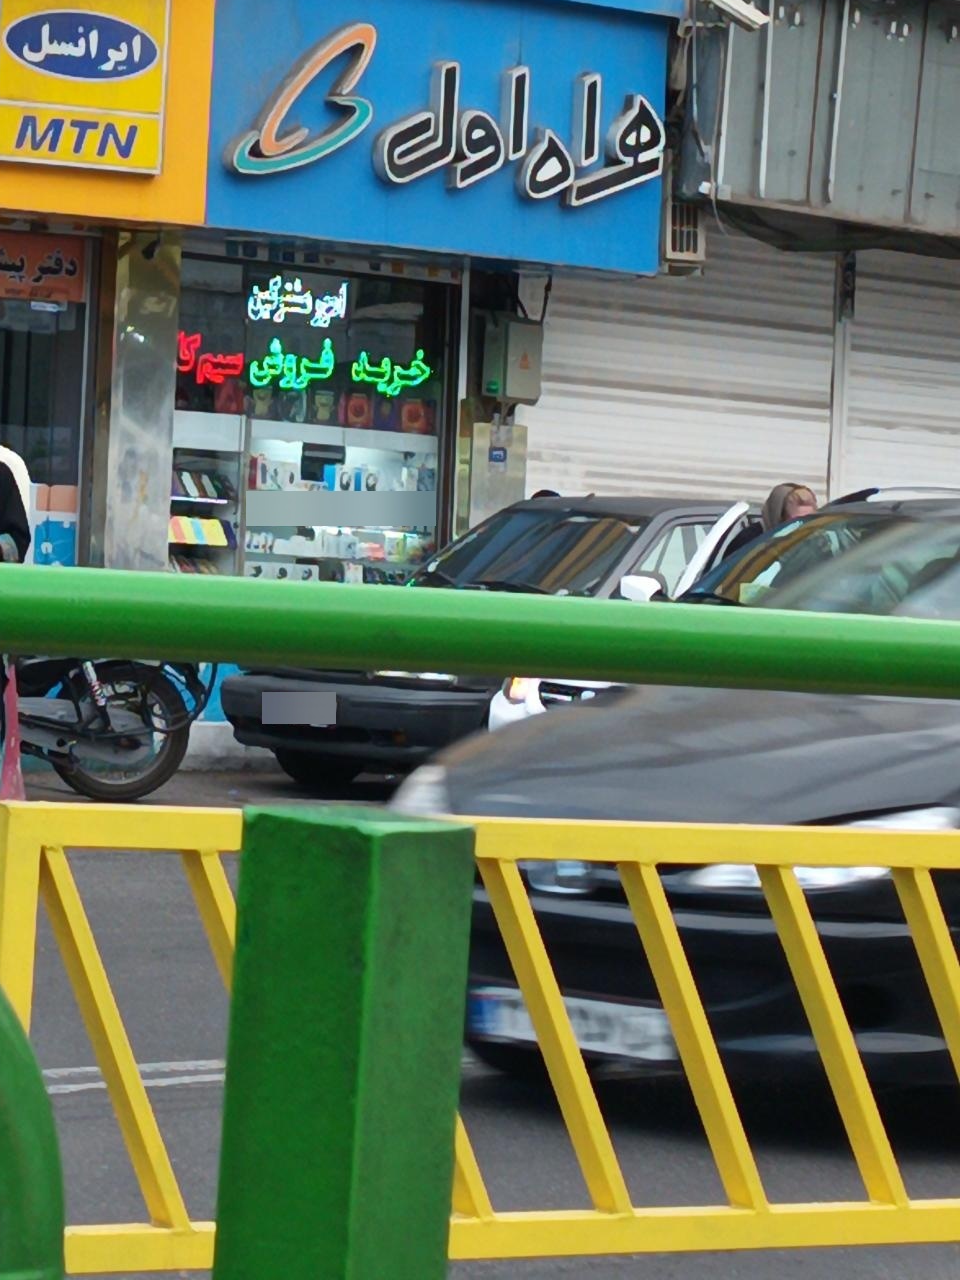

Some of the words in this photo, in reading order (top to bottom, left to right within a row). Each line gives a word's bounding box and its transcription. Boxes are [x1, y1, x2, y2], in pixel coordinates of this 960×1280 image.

[21, 21, 142, 72] ایرانسل
[14, 114, 138, 159] MTN
[374, 60, 529, 190] اول
[34, 249, 79, 283] دفتر
[196, 350, 246, 385] سیم
[250, 337, 335, 390] فروش
[352, 348, 432, 396] خرید
